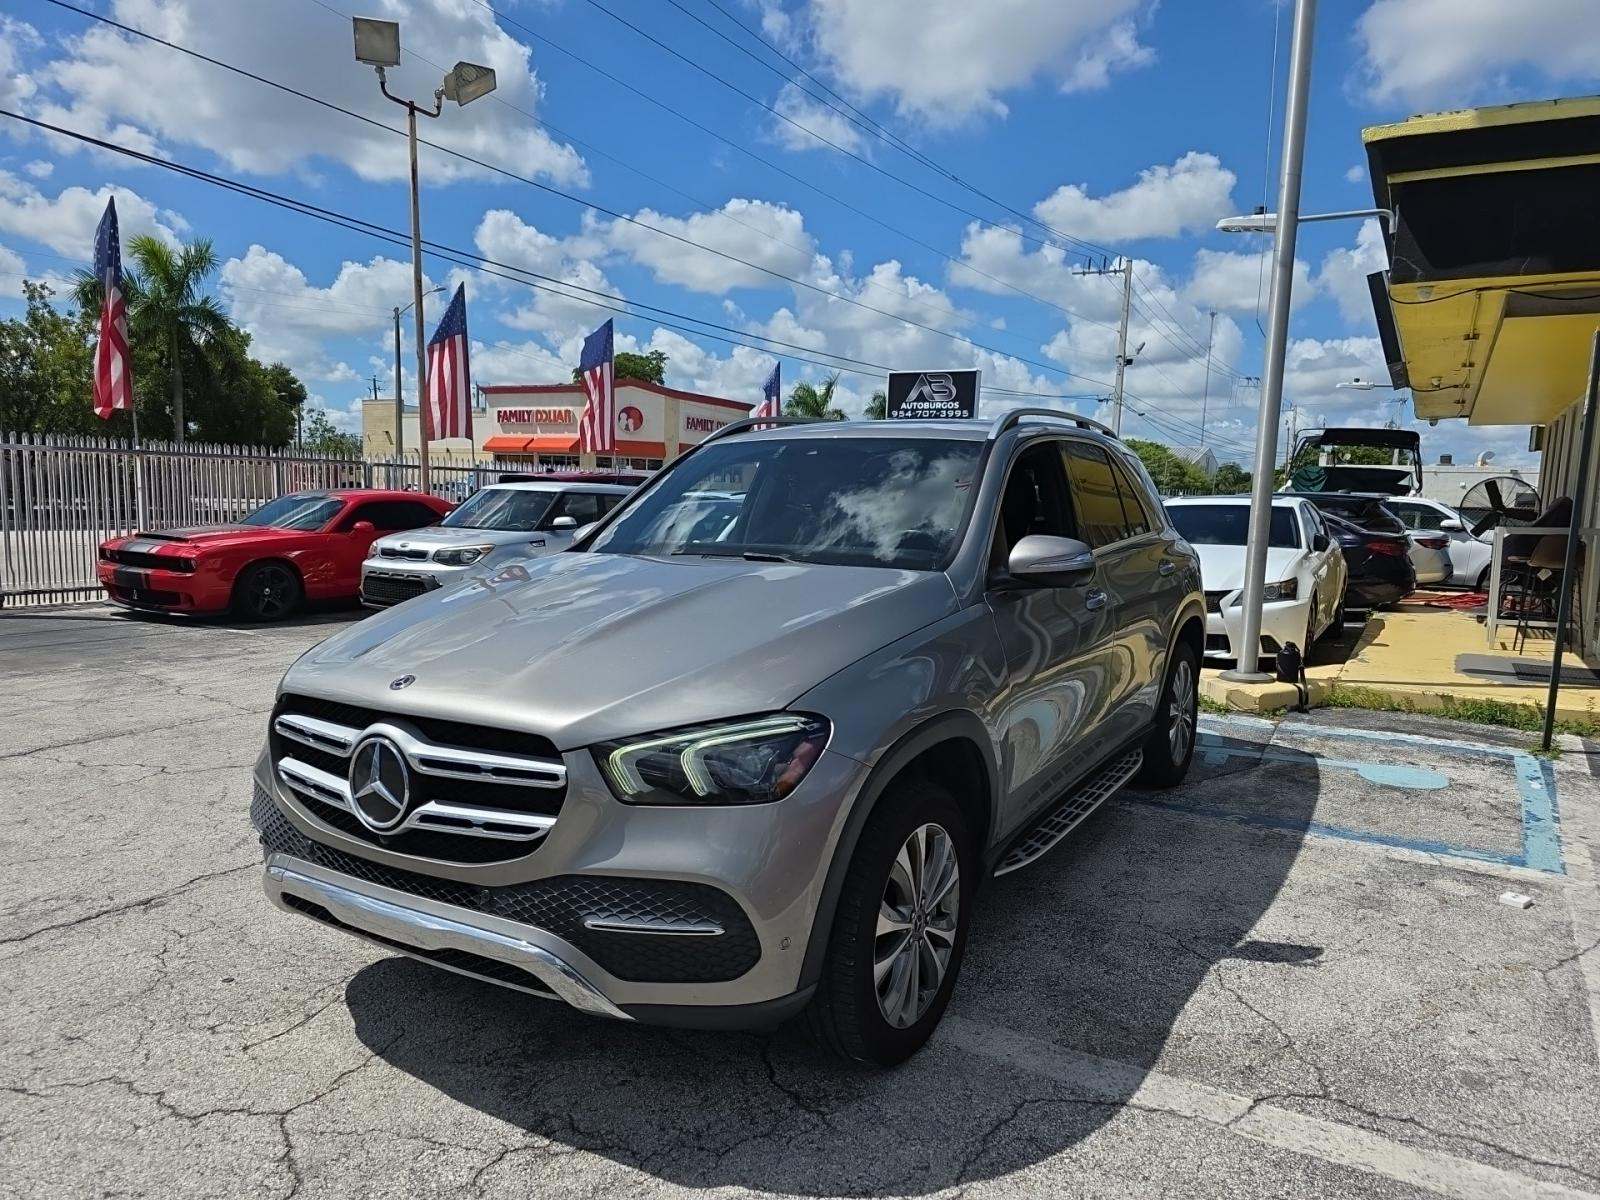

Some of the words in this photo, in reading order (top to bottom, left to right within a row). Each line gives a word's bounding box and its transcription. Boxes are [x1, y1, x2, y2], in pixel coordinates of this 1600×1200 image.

[497, 410, 532, 423] FAMILY
[535, 410, 571, 423] DOLLAR
[686, 417, 714, 432] FAMILY
